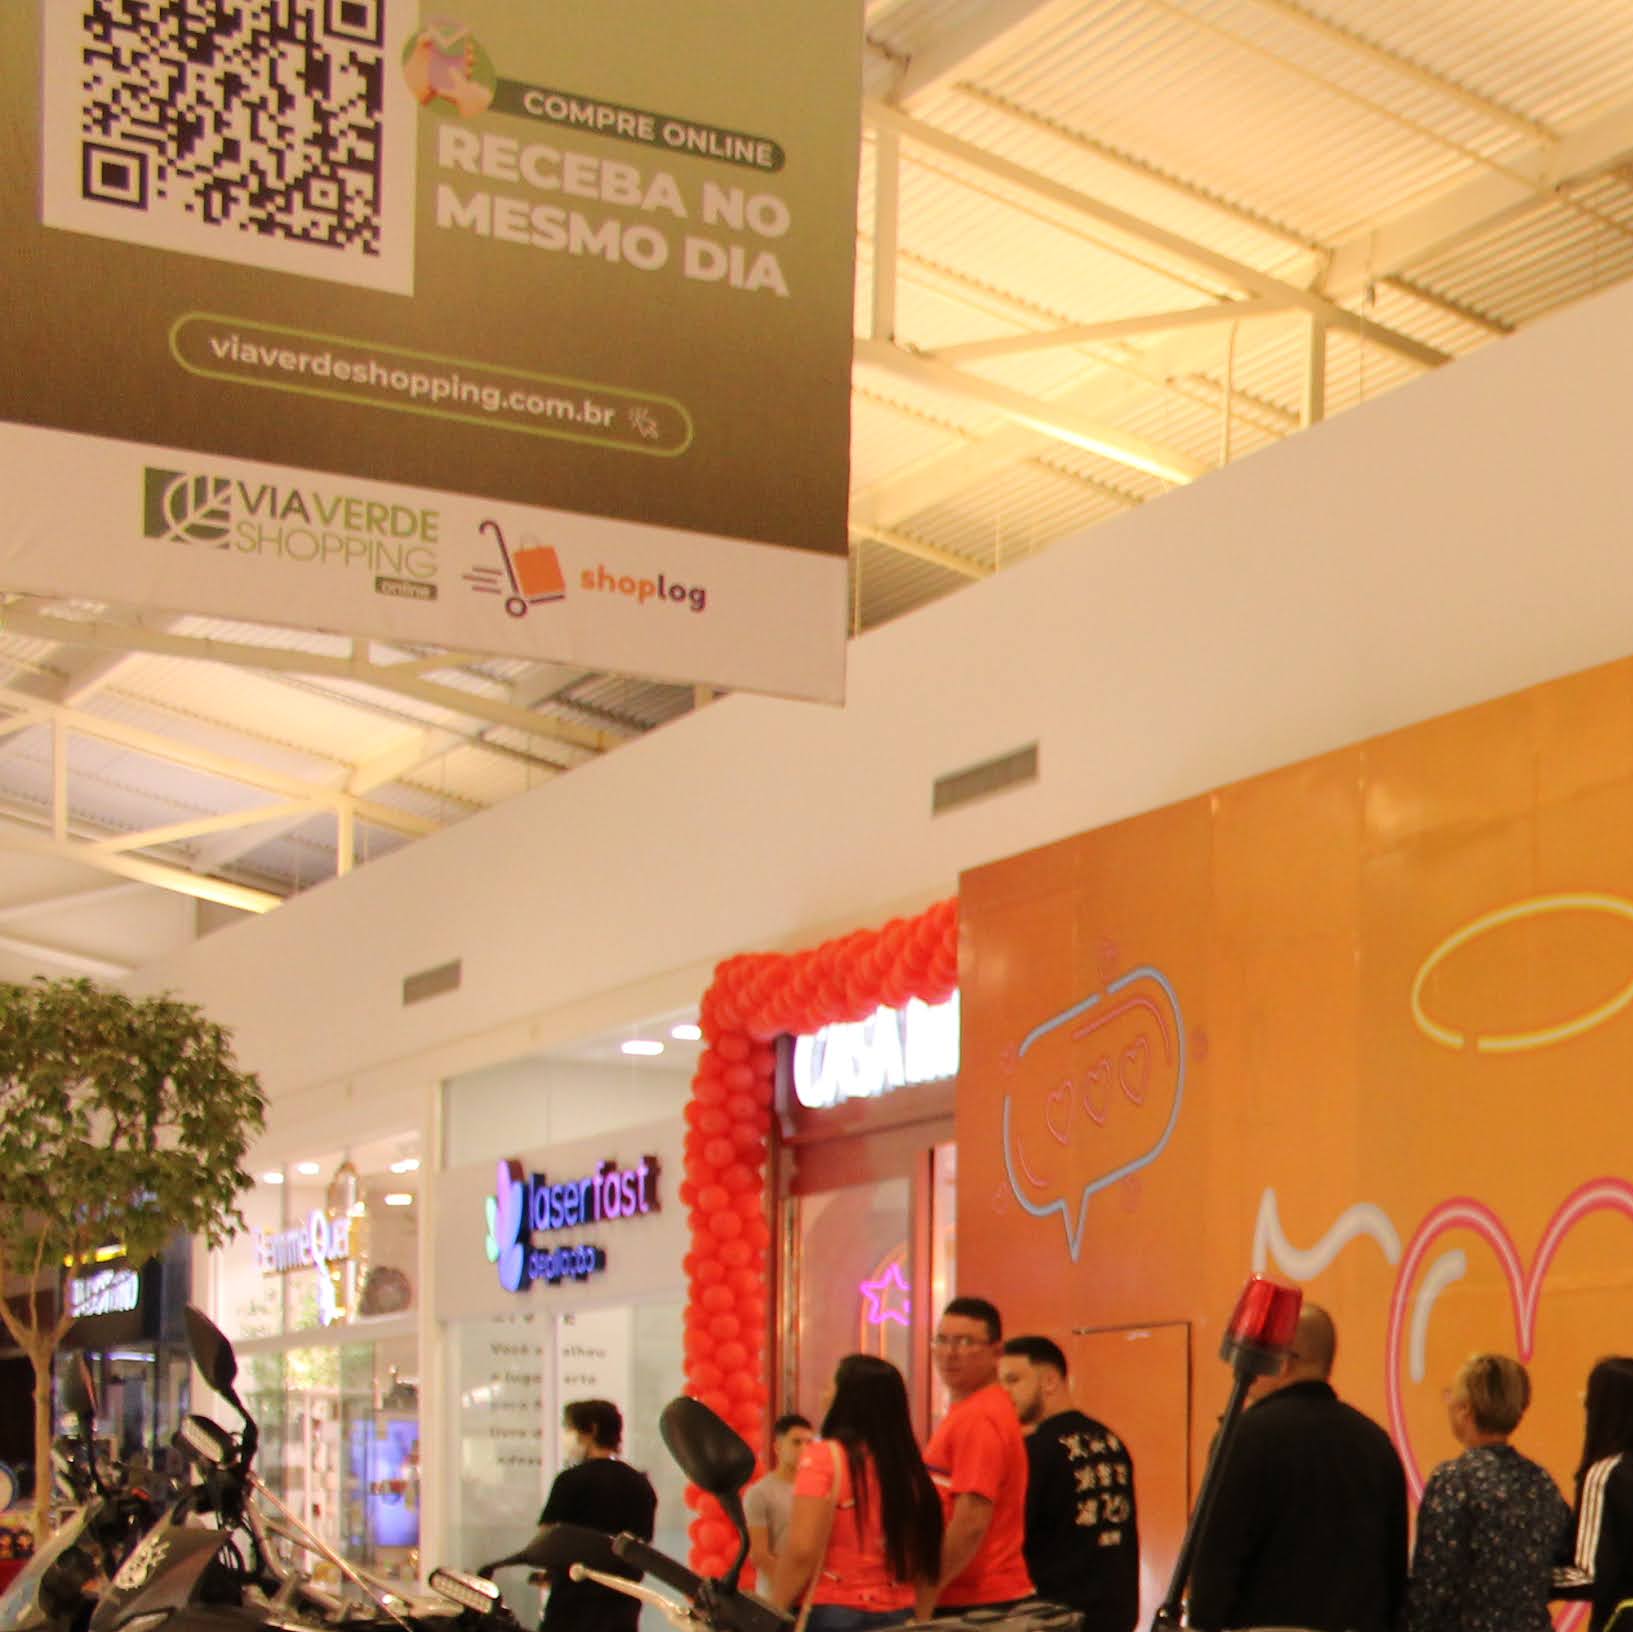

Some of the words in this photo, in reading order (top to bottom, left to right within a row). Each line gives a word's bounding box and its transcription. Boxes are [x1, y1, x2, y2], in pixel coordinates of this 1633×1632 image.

[523, 91, 655, 141] COMPRE
[663, 122, 774, 168] ONLINE
[438, 124, 688, 218] RECEBA
[702, 181, 791, 238] NO
[436, 185, 669, 271] MESMO
[684, 235, 790, 296] DIA
[209, 335, 613, 427] viaverdeshopping.com.br
[235, 520, 438, 578] SHOPPING
[580, 565, 707, 612] shoplog
